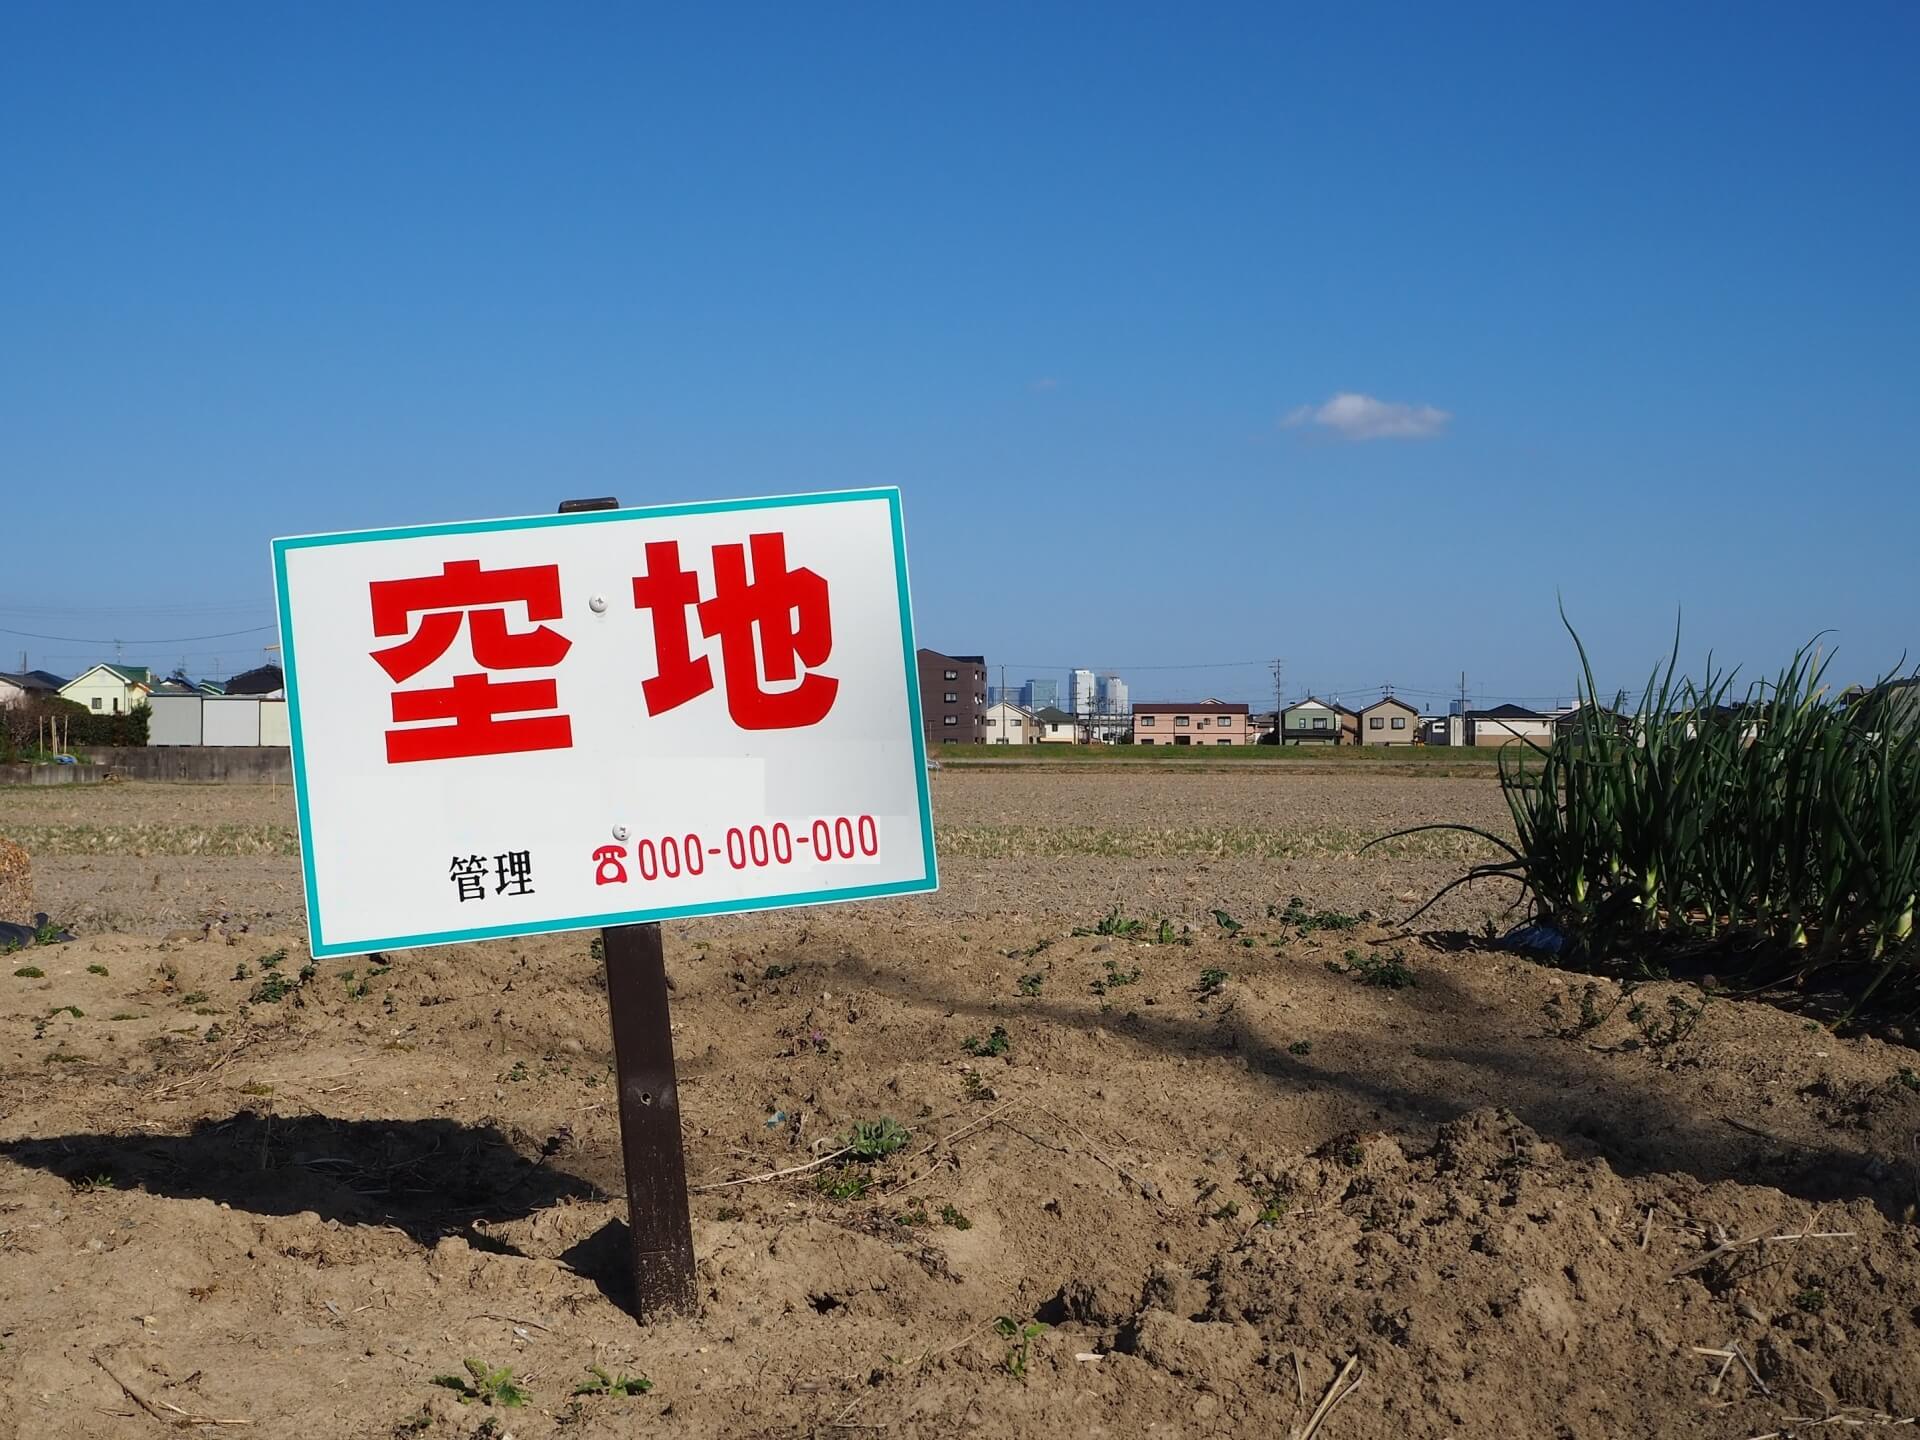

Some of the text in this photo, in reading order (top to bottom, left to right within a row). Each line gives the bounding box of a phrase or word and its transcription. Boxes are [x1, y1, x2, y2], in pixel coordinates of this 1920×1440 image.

[369, 531, 840, 765] 空地
[449, 814, 879, 903] 管理 000-000-000
